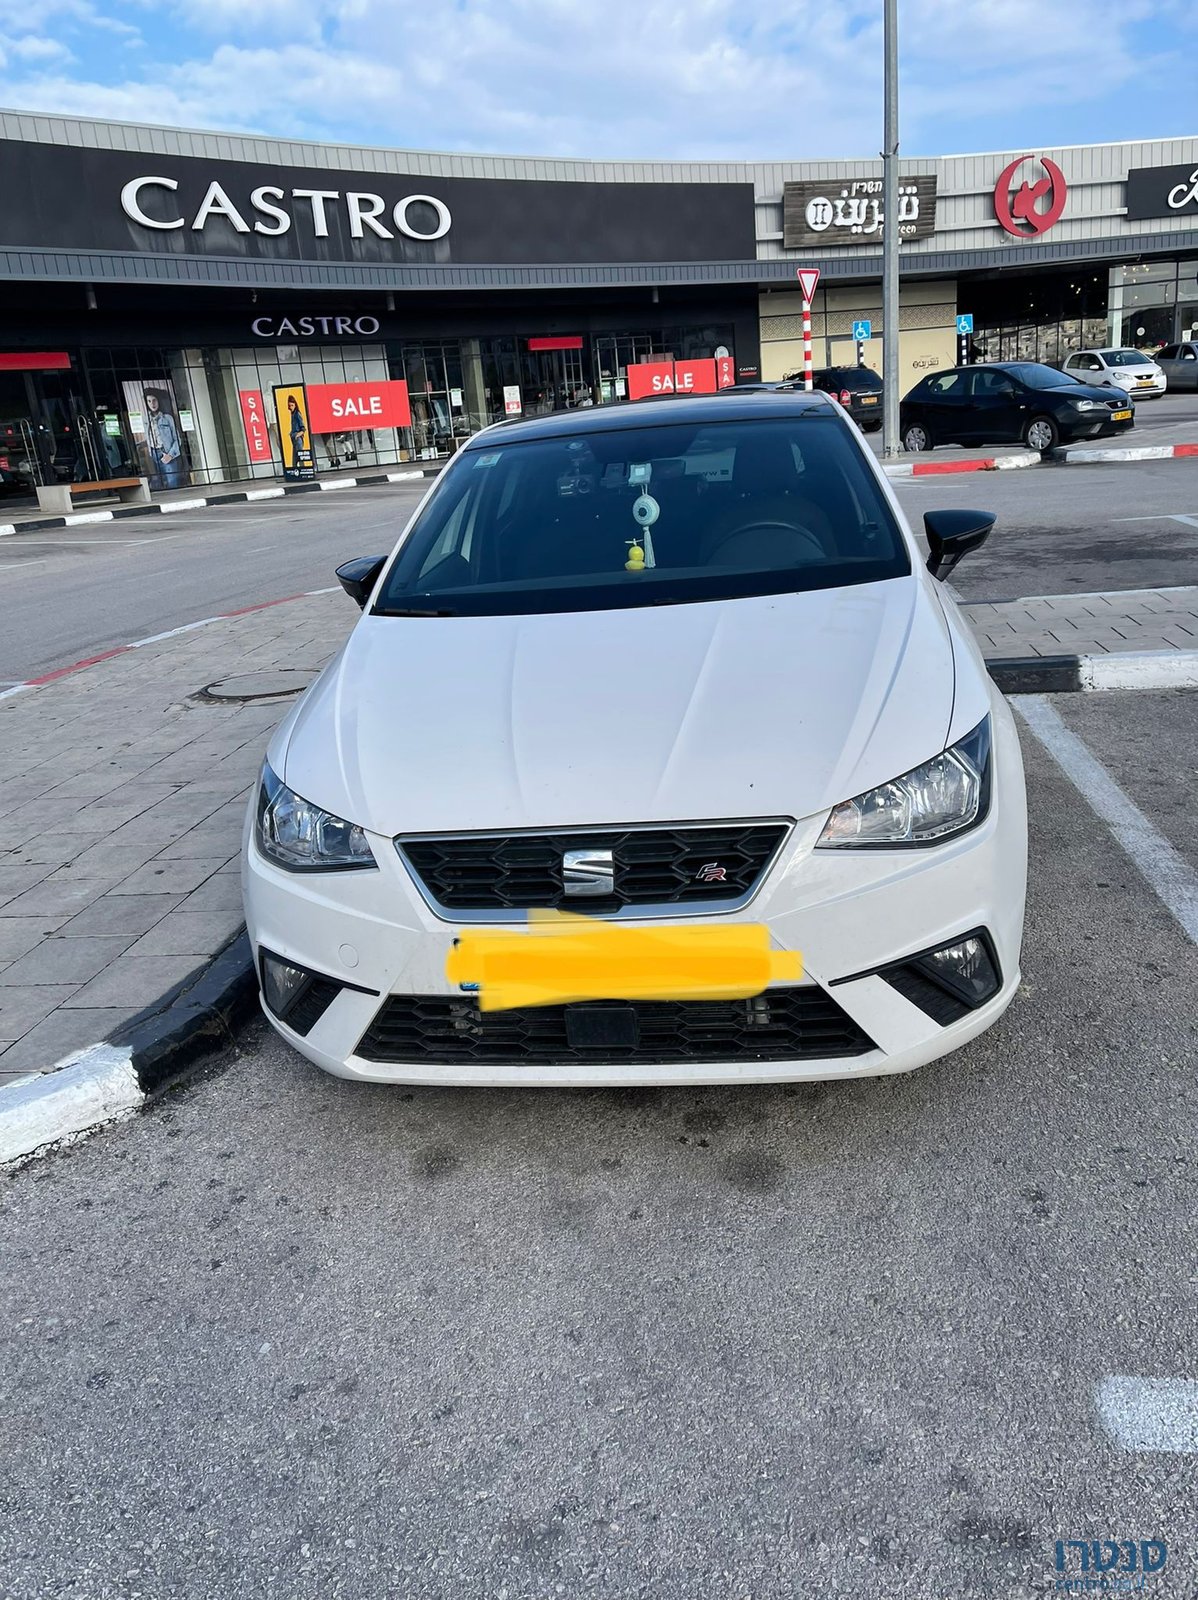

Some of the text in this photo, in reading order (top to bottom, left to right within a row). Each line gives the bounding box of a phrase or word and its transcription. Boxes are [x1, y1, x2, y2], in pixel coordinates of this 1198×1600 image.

[121, 176, 452, 240] CASTRO
[251, 316, 380, 337] CASTRO
[652, 372, 694, 390] SALE
[331, 396, 383, 417] SALE
[247, 397, 264, 451] SALE
[695, 862, 728, 882] FR
